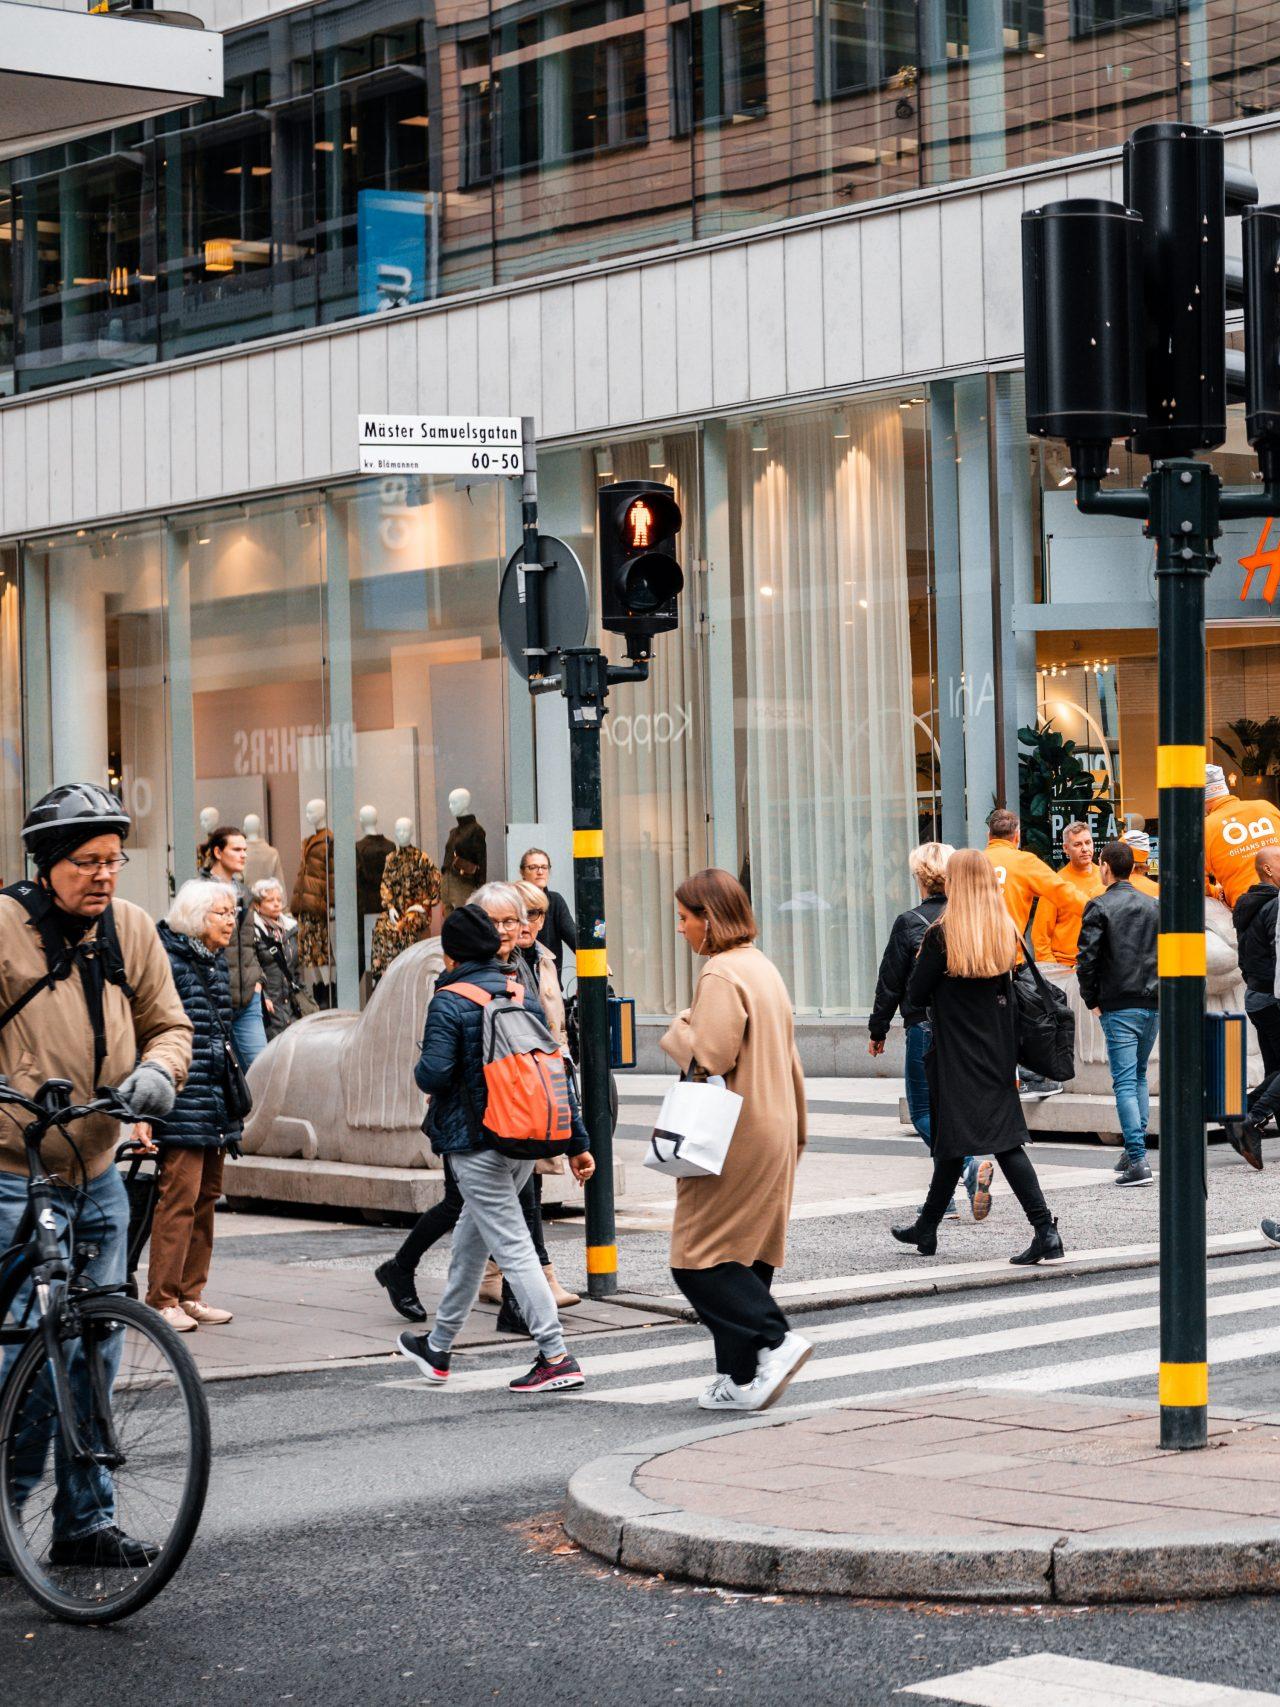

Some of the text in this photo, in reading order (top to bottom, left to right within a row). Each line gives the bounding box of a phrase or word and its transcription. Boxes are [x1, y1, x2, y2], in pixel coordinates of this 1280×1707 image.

[364, 422, 517, 443] Mäster Samuelsgatan
[472, 453, 519, 469] 60-50
[1222, 816, 1276, 845] ÖB
